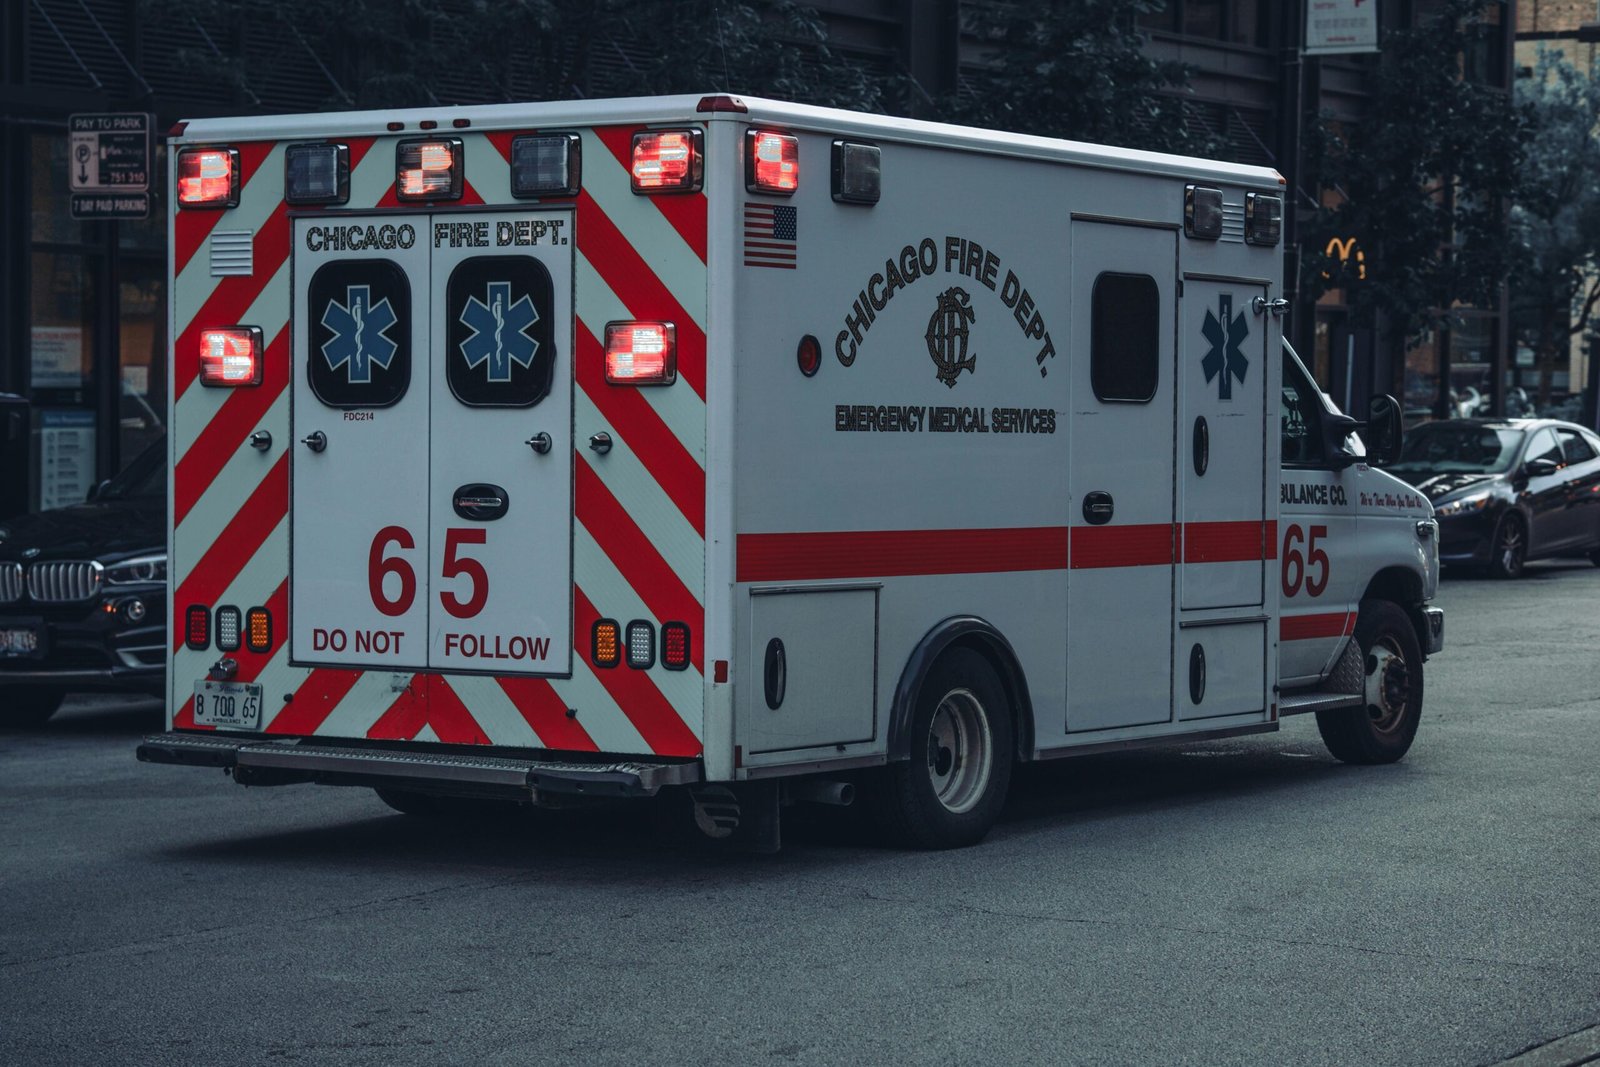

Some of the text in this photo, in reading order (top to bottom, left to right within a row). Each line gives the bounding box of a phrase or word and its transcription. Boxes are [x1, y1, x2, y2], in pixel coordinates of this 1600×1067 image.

[75, 118, 141, 129] PAY TO PARK
[81, 200, 94, 211] DAY
[96, 200, 113, 211] PAID
[114, 199, 146, 211] PARKING
[306, 219, 568, 252] CHICAGO FIRE DEPT.
[835, 236, 1056, 378] CHICAGO FIRE DEPT.
[343, 412, 374, 421] FDC214
[835, 404, 1056, 434] EMERGENCY MEDICAL SERVICES
[1329, 485, 1347, 506] CO.
[368, 525, 489, 619] 65
[1281, 523, 1329, 598] 65
[313, 628, 550, 660] DO NOT FOLLOW
[196, 694, 257, 718] 8 700 65
